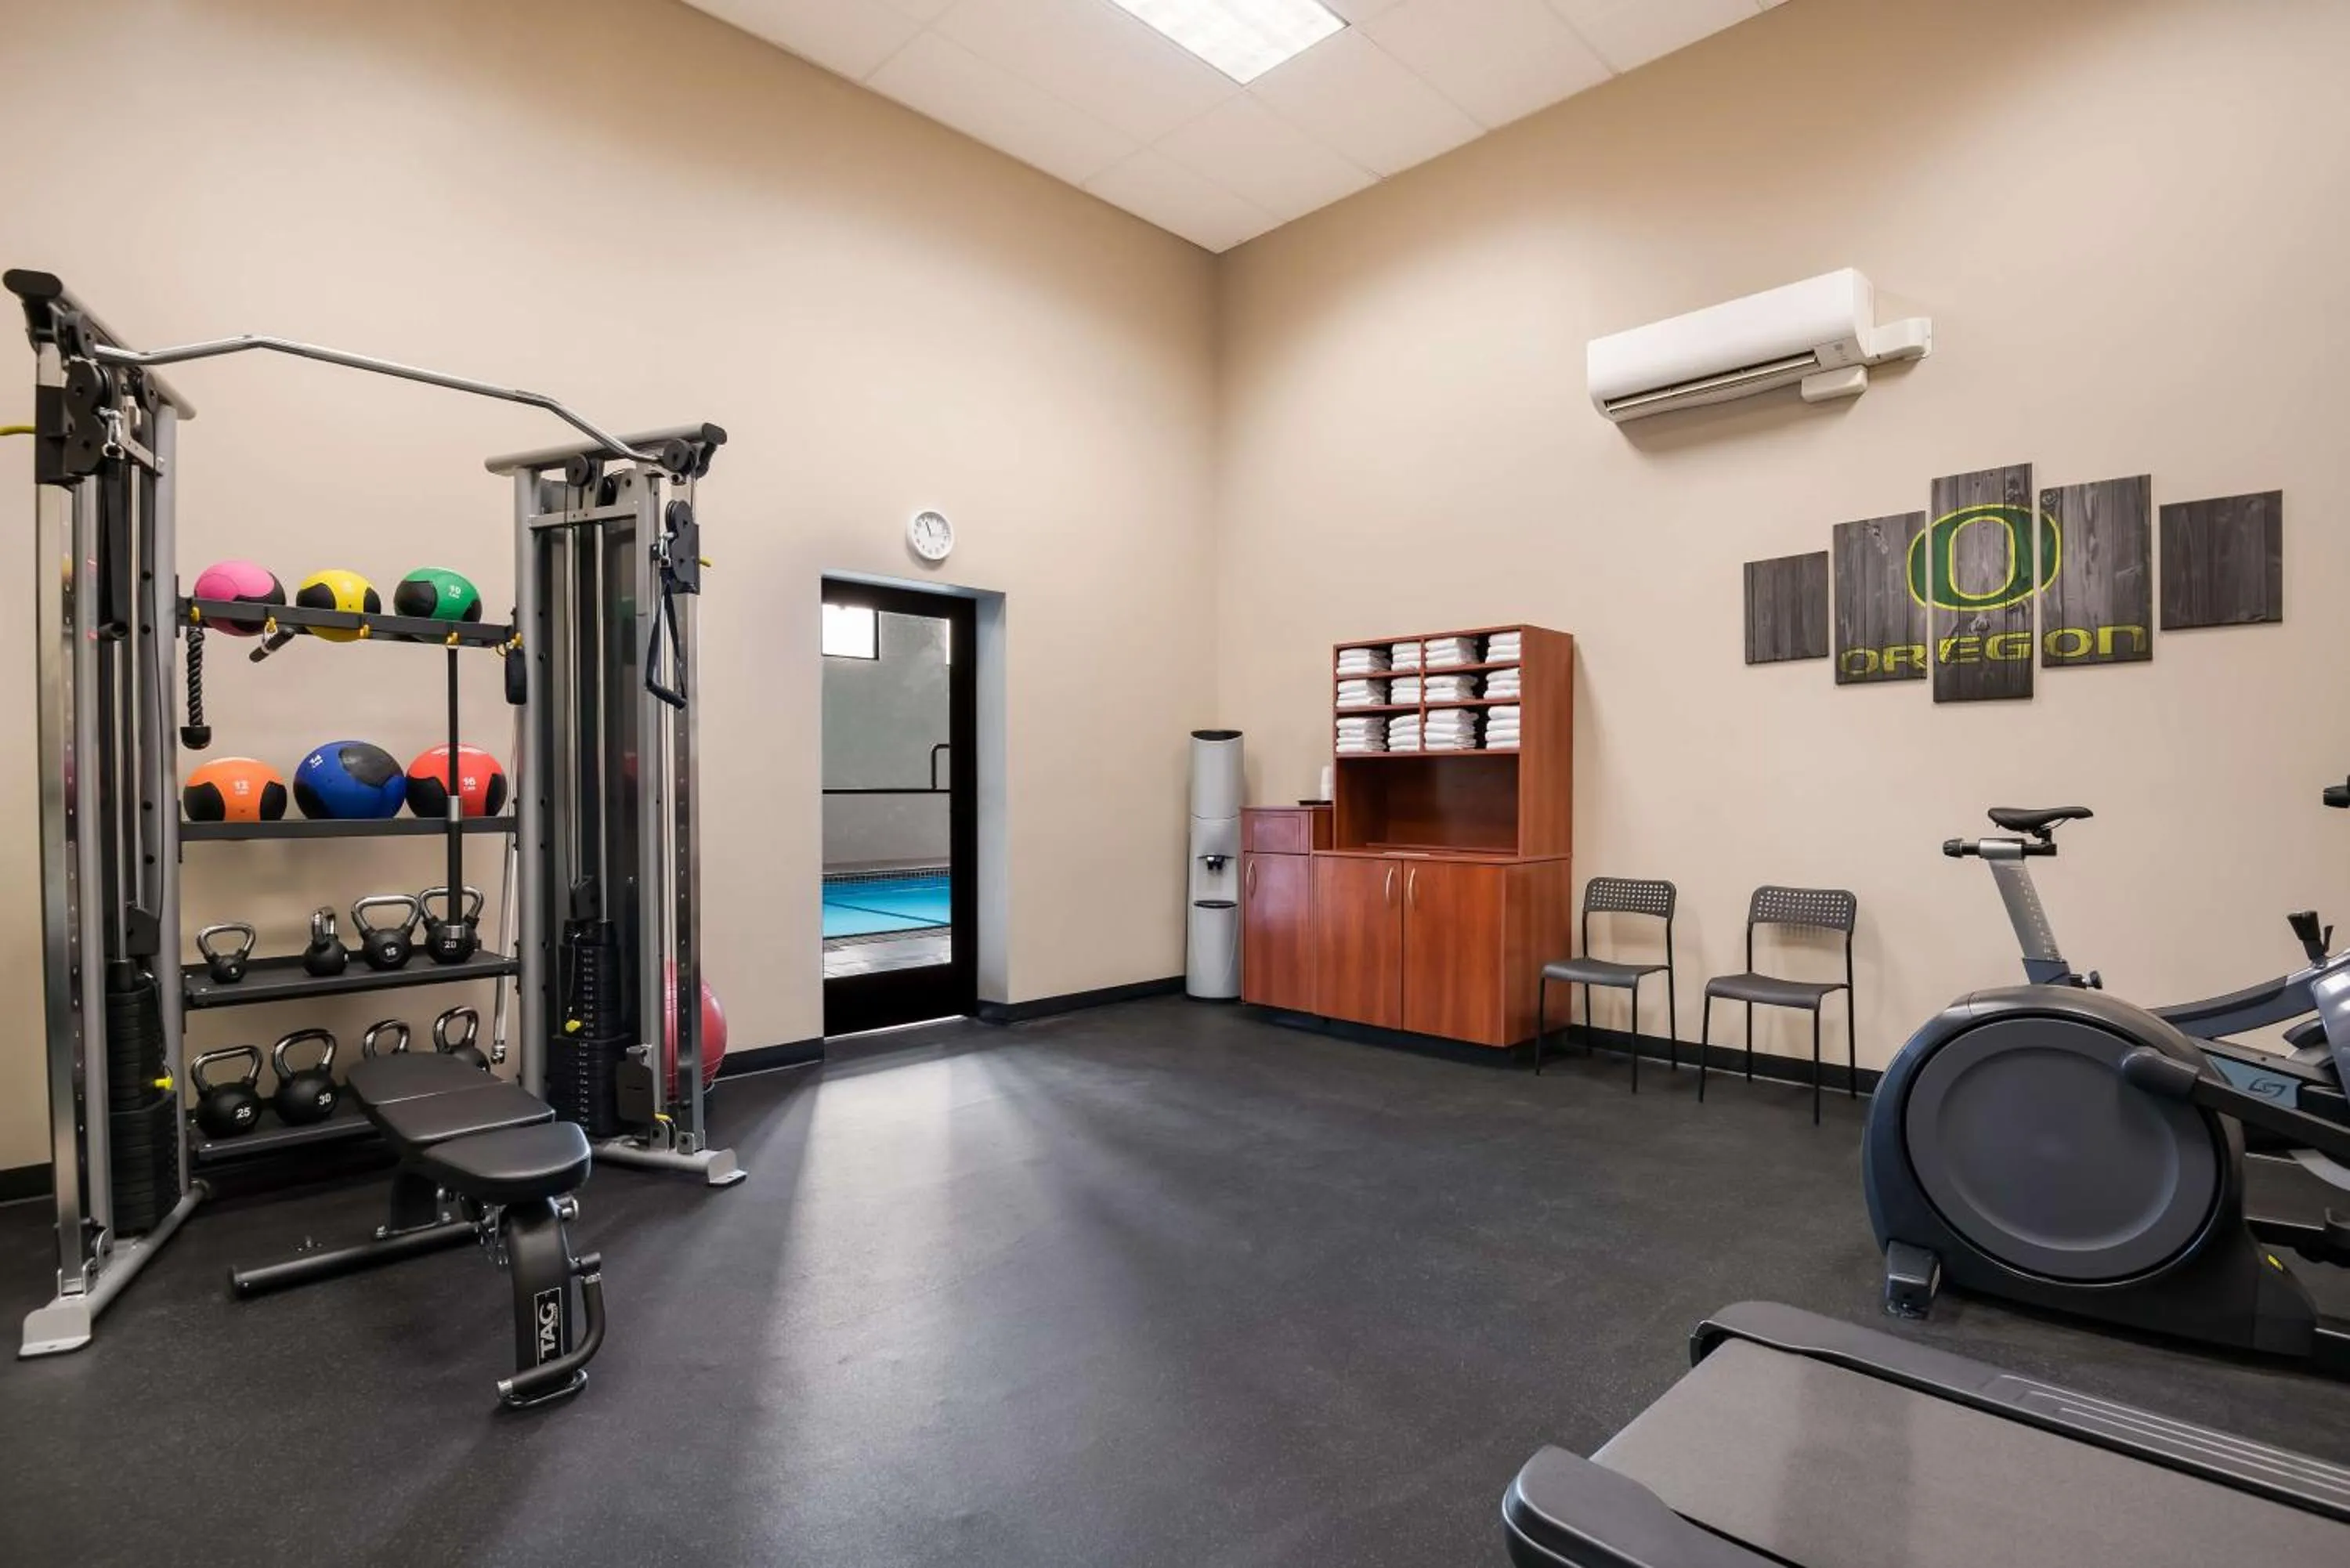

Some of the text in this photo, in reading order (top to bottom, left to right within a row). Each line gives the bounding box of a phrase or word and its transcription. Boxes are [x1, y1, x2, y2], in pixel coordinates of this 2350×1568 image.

[1839, 625, 2147, 675] OREGON
[444, 940, 457, 949] 20
[385, 947, 396, 956] 15
[319, 1093, 331, 1105] 30
[236, 1107, 251, 1120] 25
